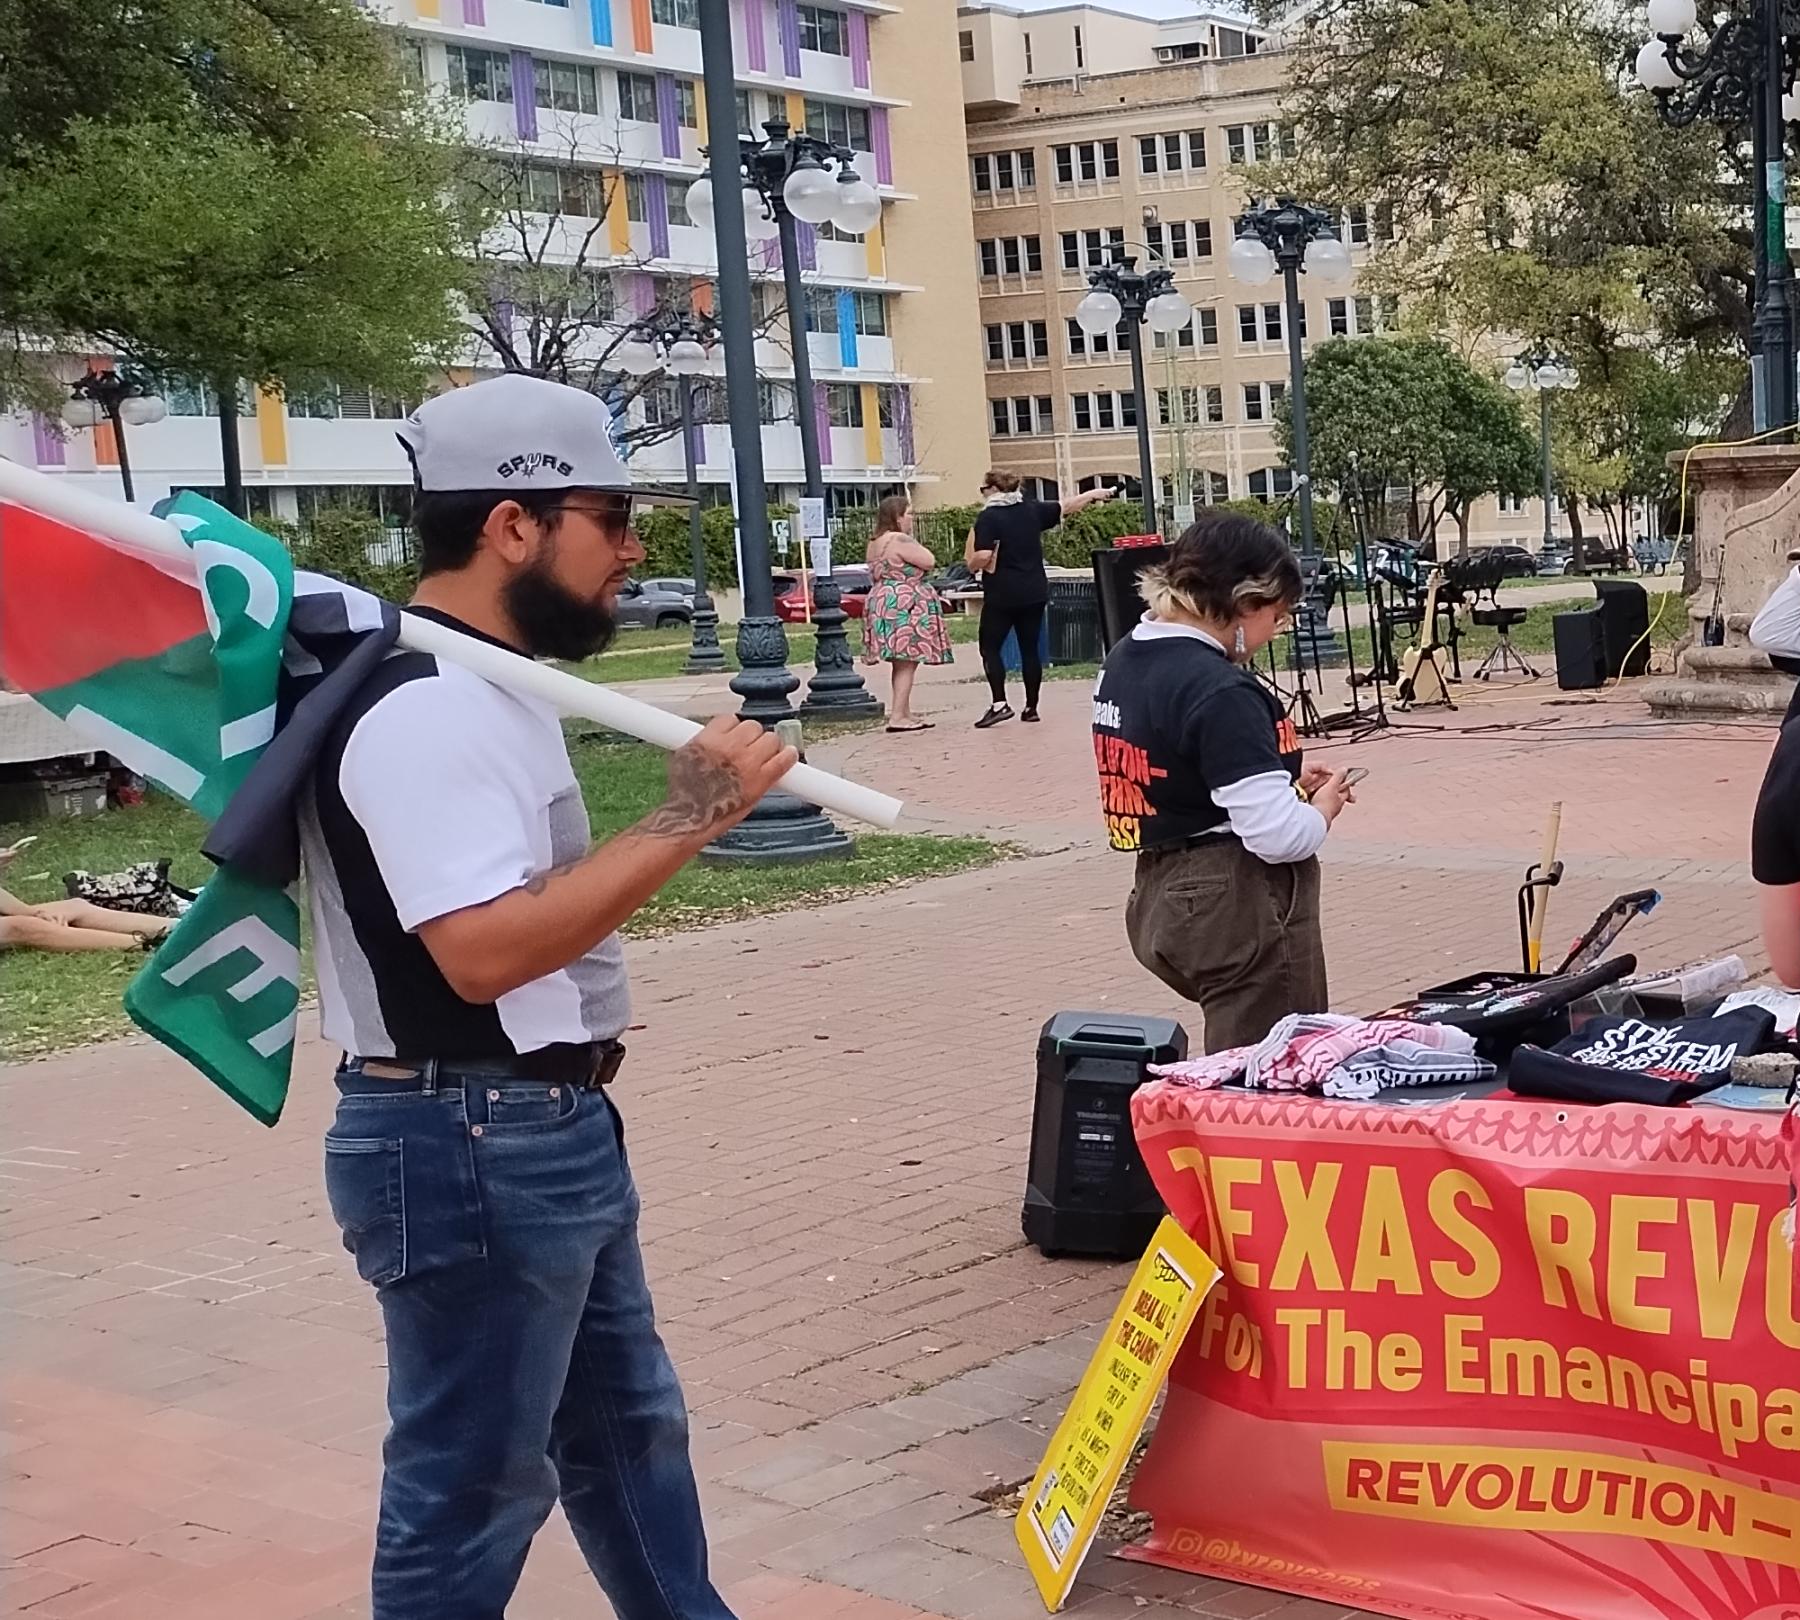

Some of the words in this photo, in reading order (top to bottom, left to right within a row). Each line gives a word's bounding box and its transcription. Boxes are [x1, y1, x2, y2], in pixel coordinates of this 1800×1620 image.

[497, 453, 574, 478] SPURS
[1167, 1147, 1501, 1299] TEXAS
[1200, 1284, 1262, 1379] For
[1276, 1308, 1423, 1392] The
[1346, 1459, 1736, 1537] REVOLUTION
